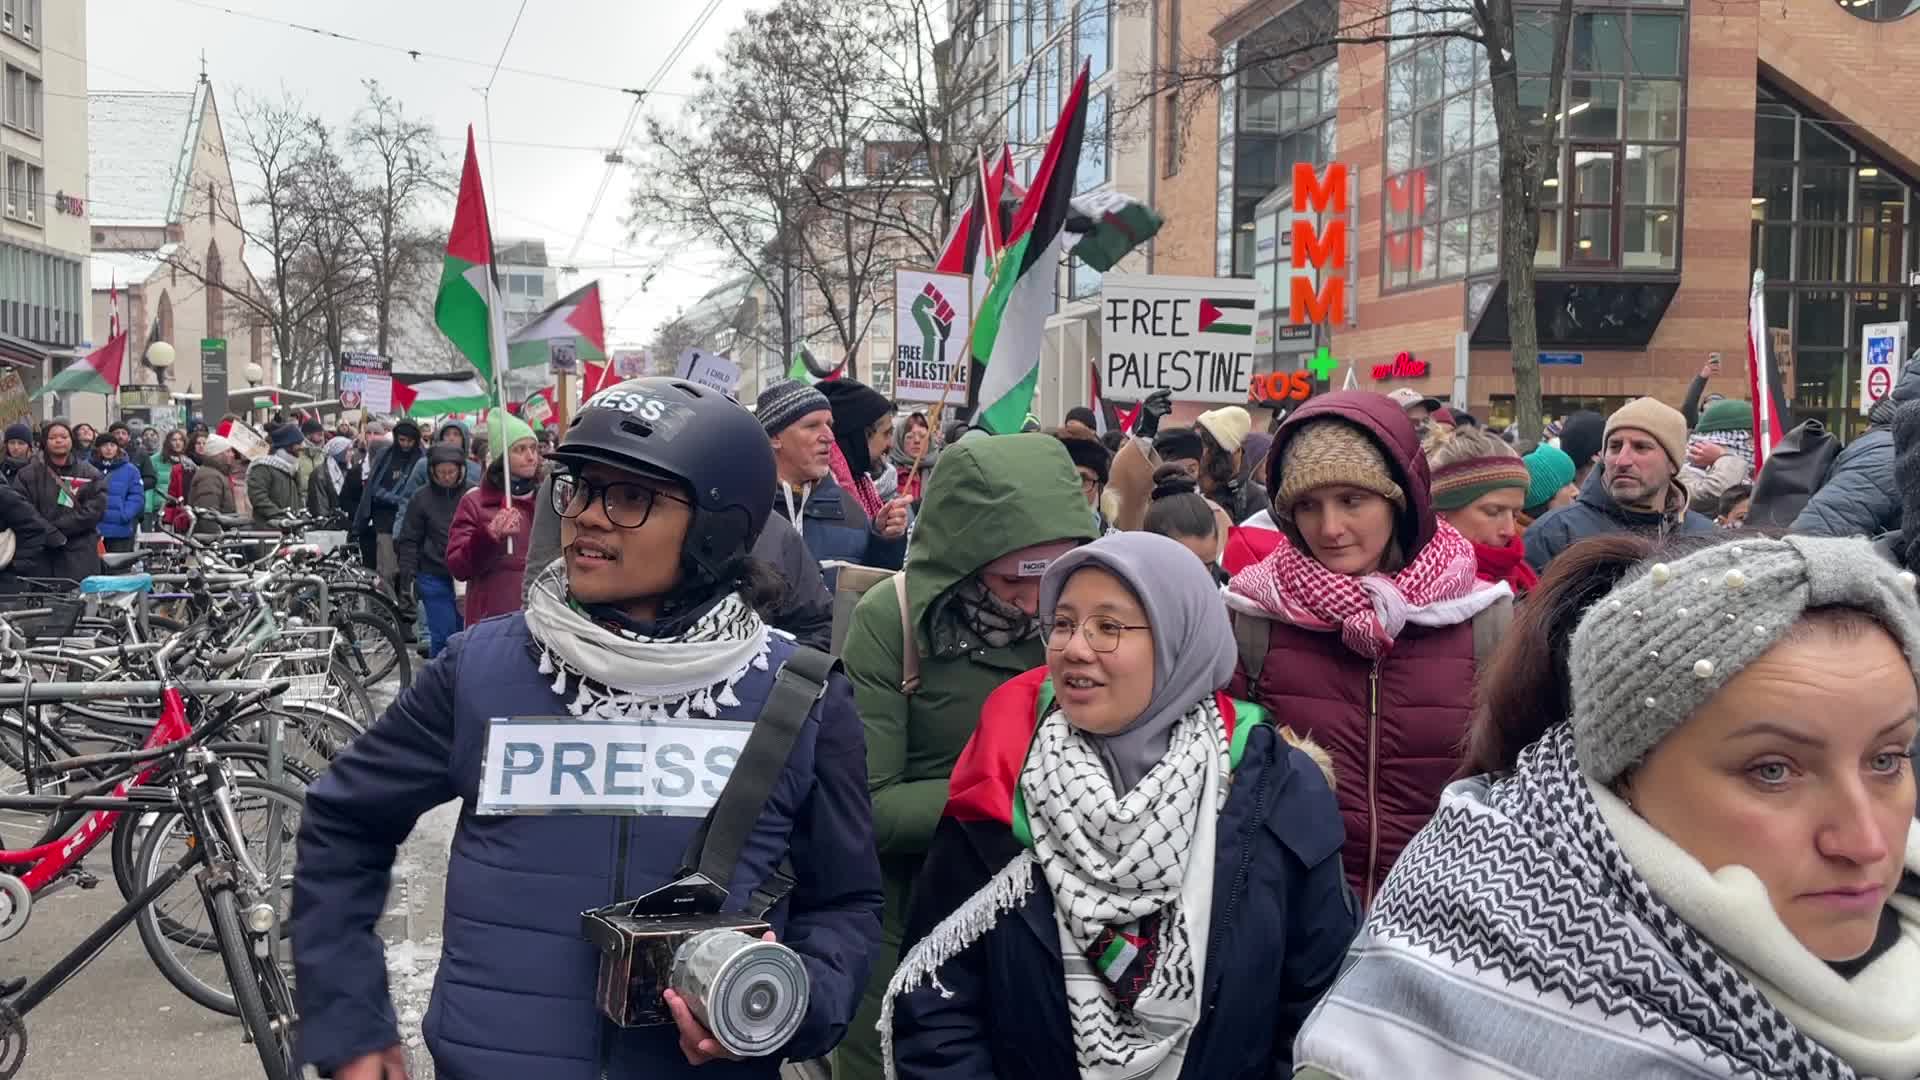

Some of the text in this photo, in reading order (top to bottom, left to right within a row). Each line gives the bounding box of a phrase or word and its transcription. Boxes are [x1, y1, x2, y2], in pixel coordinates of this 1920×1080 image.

[1106, 299, 1191, 336] FREE
[898, 345, 921, 361] FREE
[1108, 350, 1252, 393] PALESTINE
[588, 391, 665, 421] RESS
[1023, 562, 1046, 571] NOIR
[500, 742, 740, 797] PRESS
